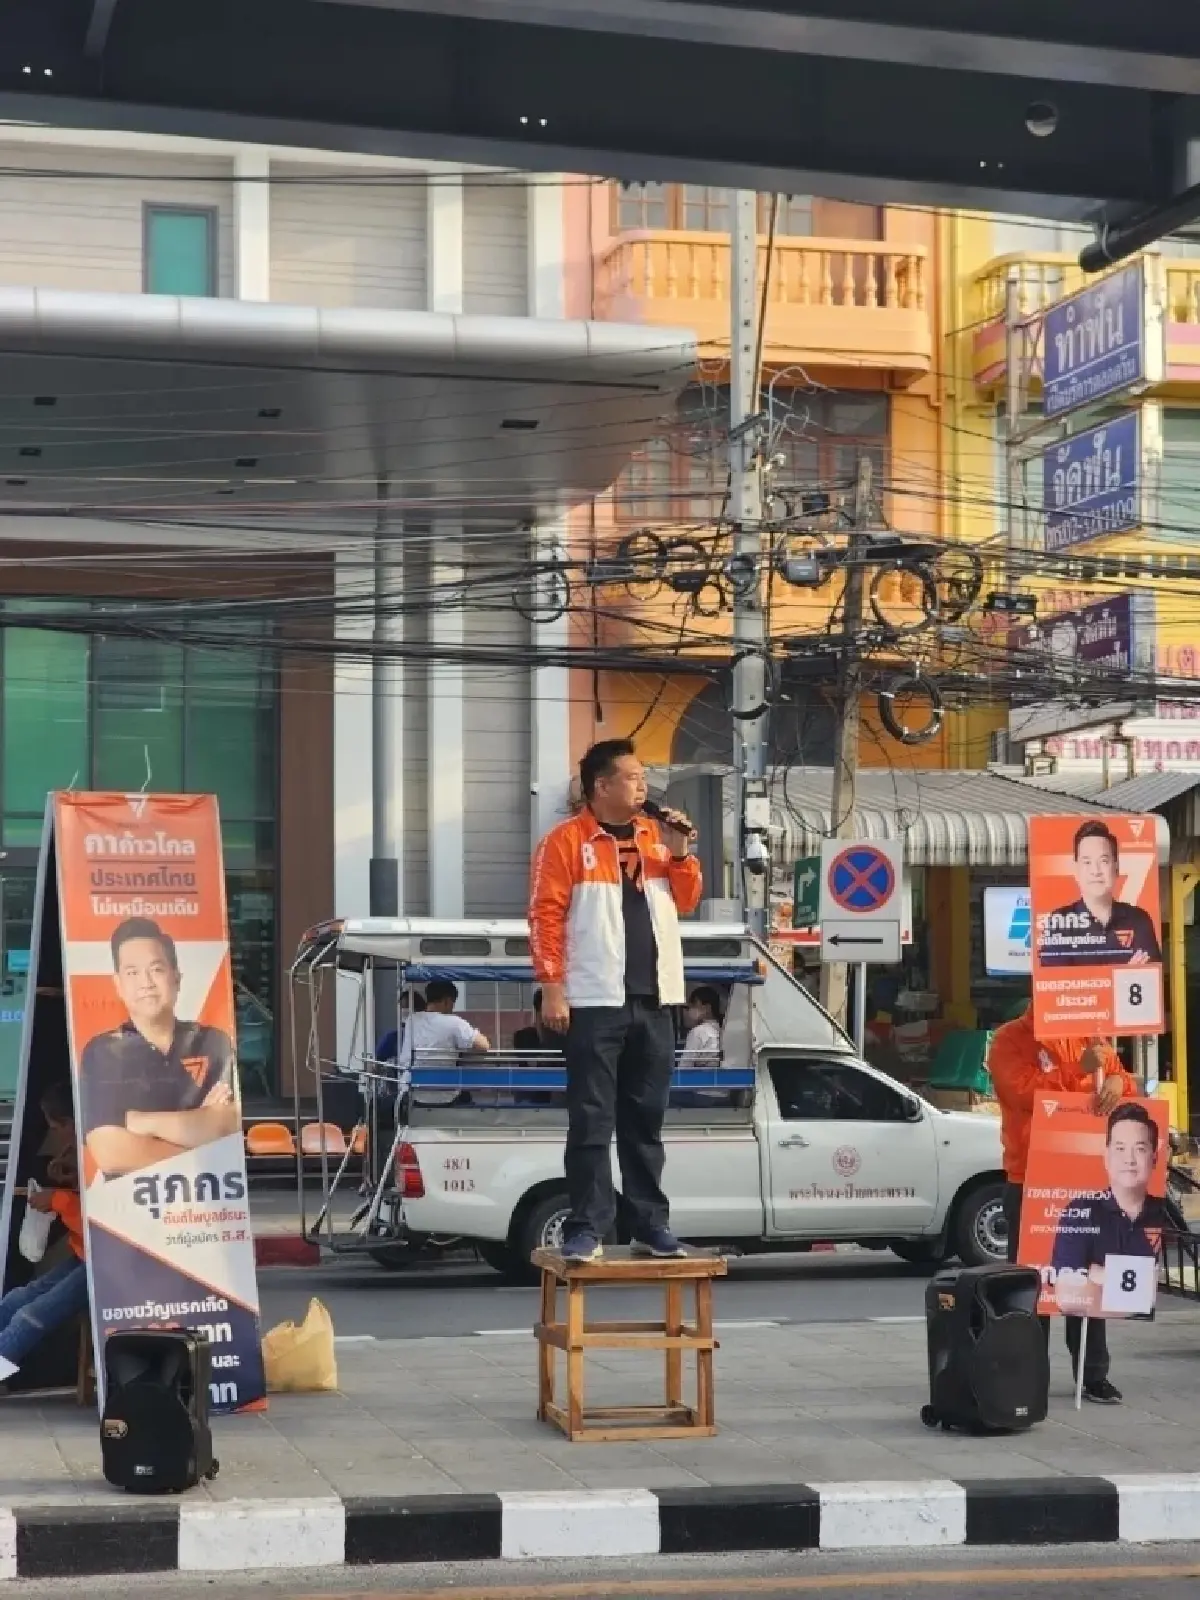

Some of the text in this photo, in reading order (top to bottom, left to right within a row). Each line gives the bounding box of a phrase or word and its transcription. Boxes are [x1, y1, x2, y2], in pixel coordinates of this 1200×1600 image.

[1055, 293, 1124, 373] ทำฟัน
[91, 866, 195, 887] ประเทศไทย
[91, 895, 199, 917] ไม่เหมือนเดิม
[1127, 983, 1143, 1006] 8
[443, 1158, 471, 1171] 48/1
[133, 1171, 245, 1219] สุภกร
[444, 1179, 476, 1192] 1013
[1044, 1203, 1092, 1219] ประเวศ
[1120, 1269, 1138, 1292] 8
[102, 1295, 228, 1320] ของขวัญแรกเกิด
[186, 1322, 233, 1343] าท
[208, 1381, 238, 1404] าท
